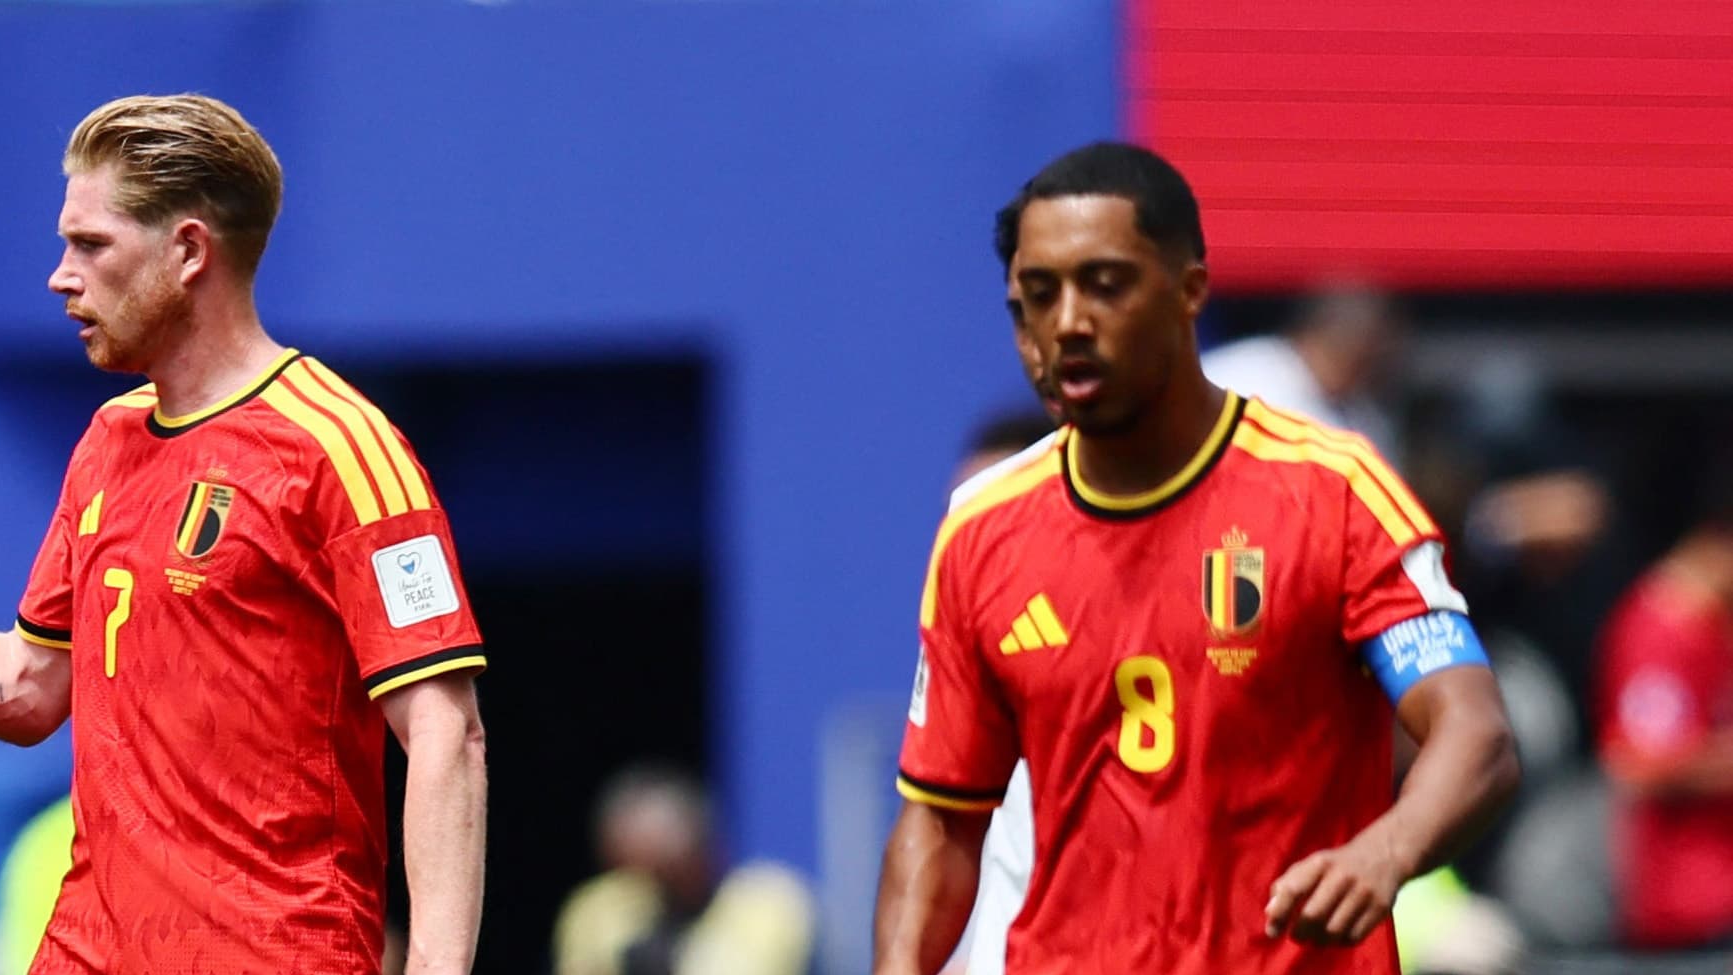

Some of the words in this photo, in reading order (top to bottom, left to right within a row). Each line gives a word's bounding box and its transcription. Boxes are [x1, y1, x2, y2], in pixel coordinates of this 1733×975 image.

[103, 568, 134, 678] 7
[404, 586, 436, 606] PEACE
[1115, 655, 1175, 773] 8
